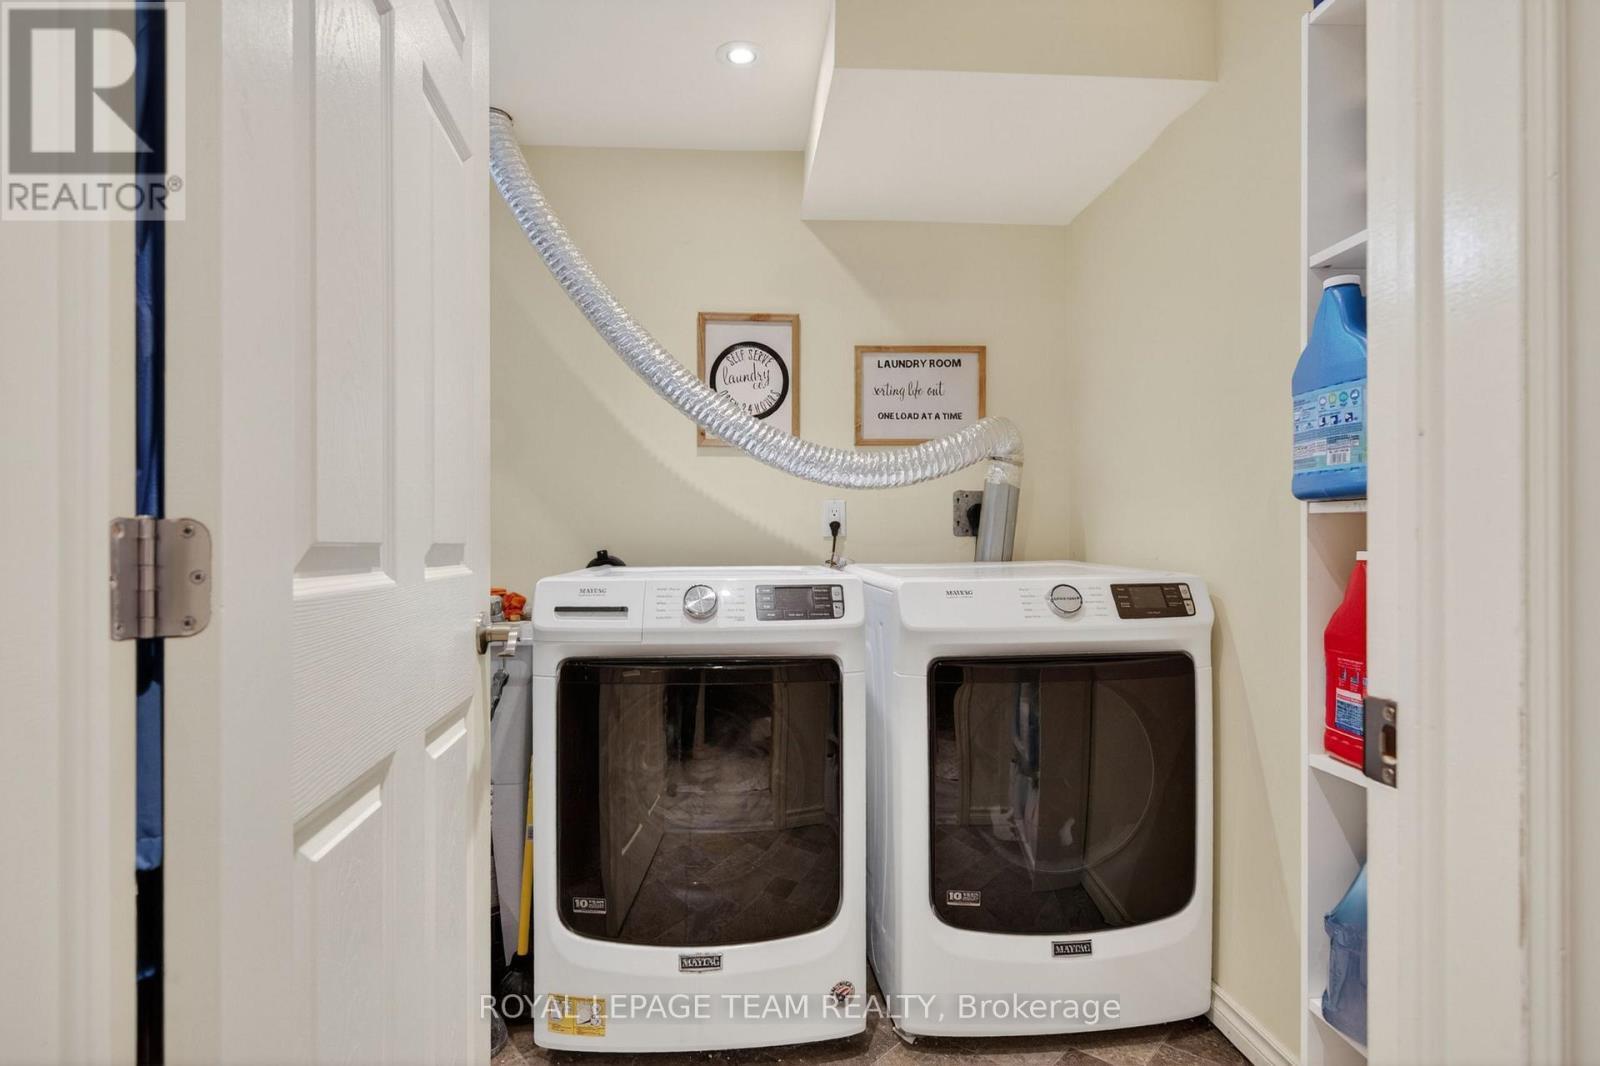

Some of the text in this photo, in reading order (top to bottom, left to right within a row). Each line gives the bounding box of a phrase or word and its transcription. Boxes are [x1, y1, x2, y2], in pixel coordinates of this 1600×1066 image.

[726, 349, 774, 367] SELF SERVE
[877, 358, 962, 369] LAUNDRY ROOM
[722, 361, 770, 386] laundry
[873, 380, 945, 401] sorting life out
[741, 402, 753, 415] 24
[754, 389, 781, 413] HOURS
[877, 412, 963, 420] ONE LOAD AT A TIME
[948, 892, 962, 900] 10
[574, 899, 589, 908] 10
[1055, 943, 1091, 954] MAYTAG
[681, 957, 720, 968] MAYTAG
